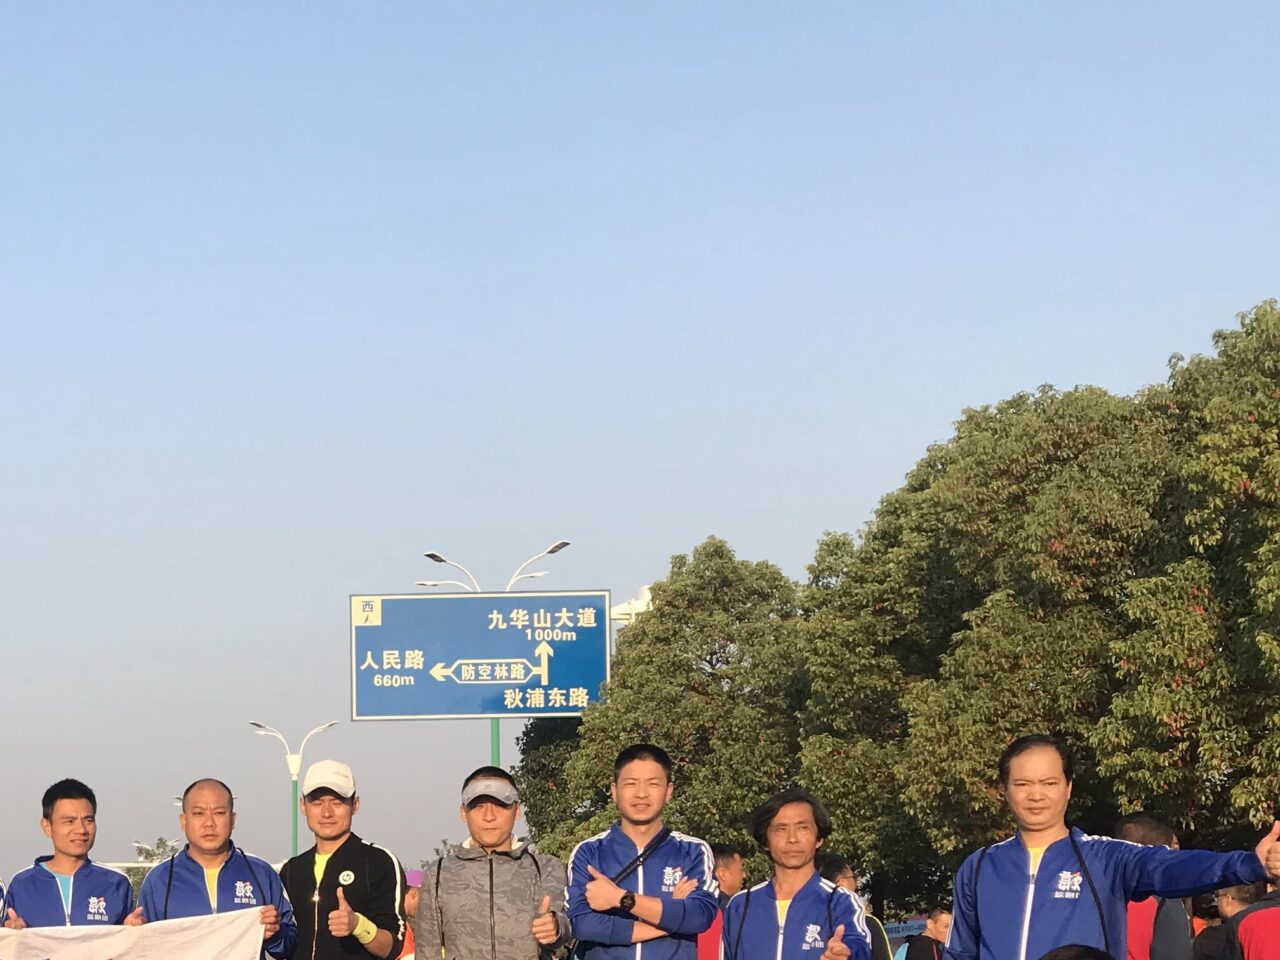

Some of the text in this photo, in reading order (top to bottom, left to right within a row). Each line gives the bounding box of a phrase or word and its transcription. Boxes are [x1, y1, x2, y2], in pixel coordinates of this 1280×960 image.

[488, 607, 597, 630] 九华山大道
[525, 628, 577, 641] 1000m
[360, 649, 424, 670] 人民路
[373, 674, 415, 687] 660m
[461, 663, 526, 681] 防空林路
[503, 687, 589, 709] 秋浦东路
